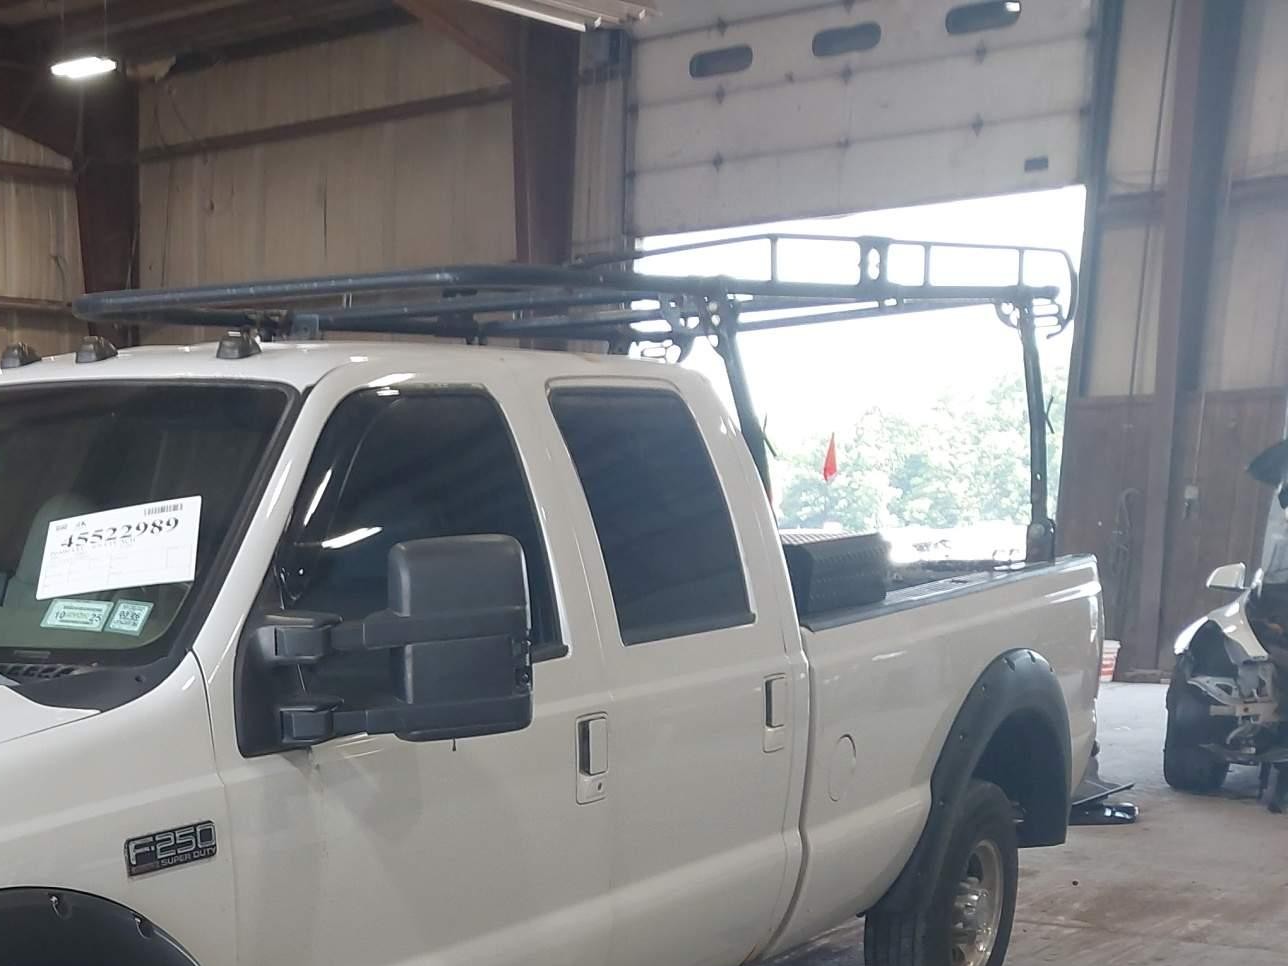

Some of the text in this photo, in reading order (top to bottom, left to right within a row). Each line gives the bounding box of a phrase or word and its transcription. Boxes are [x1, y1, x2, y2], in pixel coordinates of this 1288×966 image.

[61, 517, 179, 548] 45522989
[129, 823, 215, 865] F-250
[161, 847, 216, 866] SUPER DUTY
